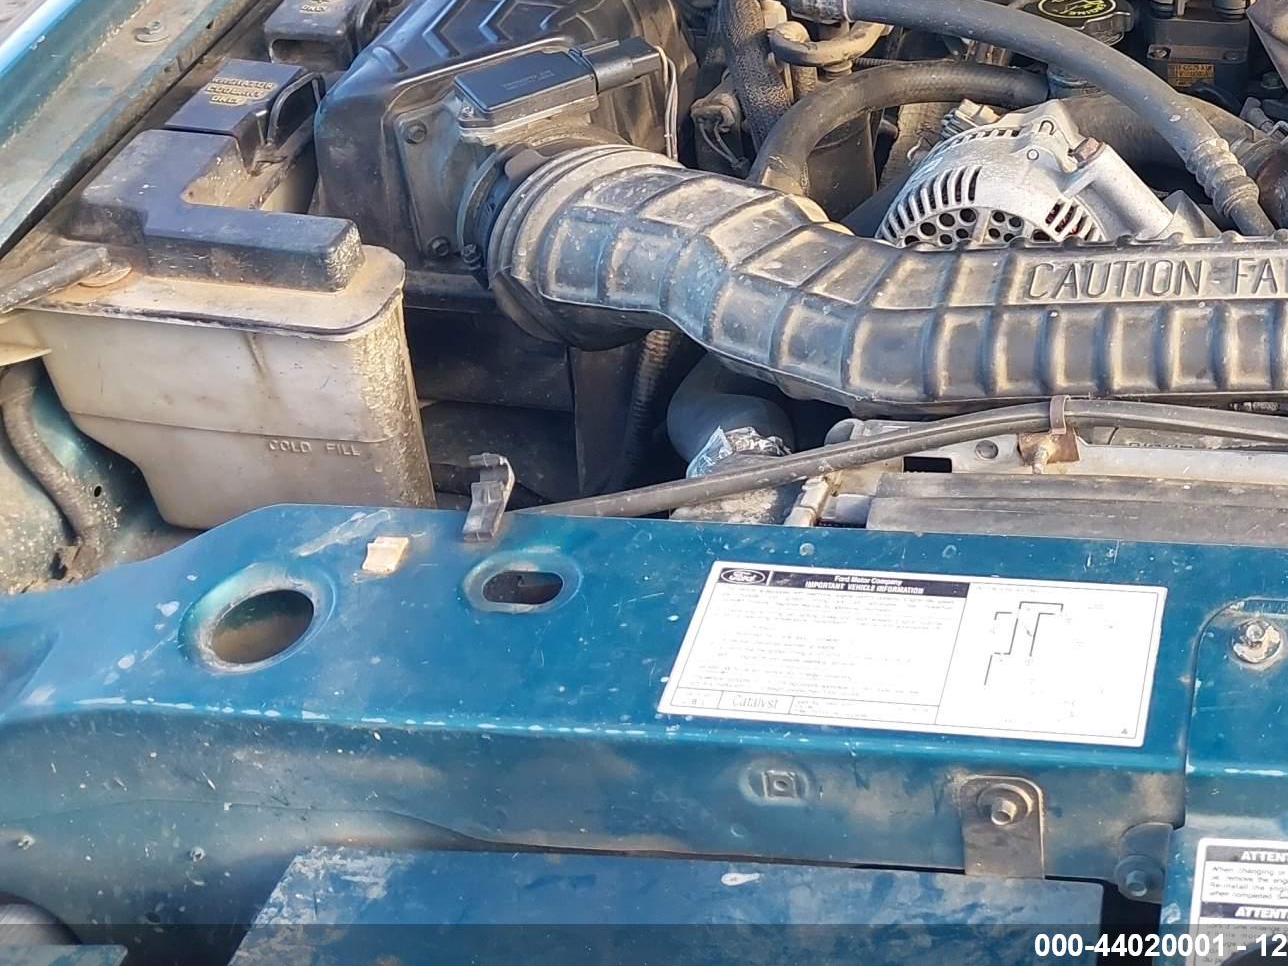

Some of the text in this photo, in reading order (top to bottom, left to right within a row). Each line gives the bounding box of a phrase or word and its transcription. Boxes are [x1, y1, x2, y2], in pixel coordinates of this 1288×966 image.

[211, 77, 273, 90] RADIATOR
[1026, 260, 1205, 300] CAUTION
[268, 439, 361, 457] COLD FILL
[804, 580, 925, 595] IMPORTANT VEHICLE INFORMATION
[834, 575, 903, 586] Ford Motor Company
[732, 694, 779, 708] Catalyst
